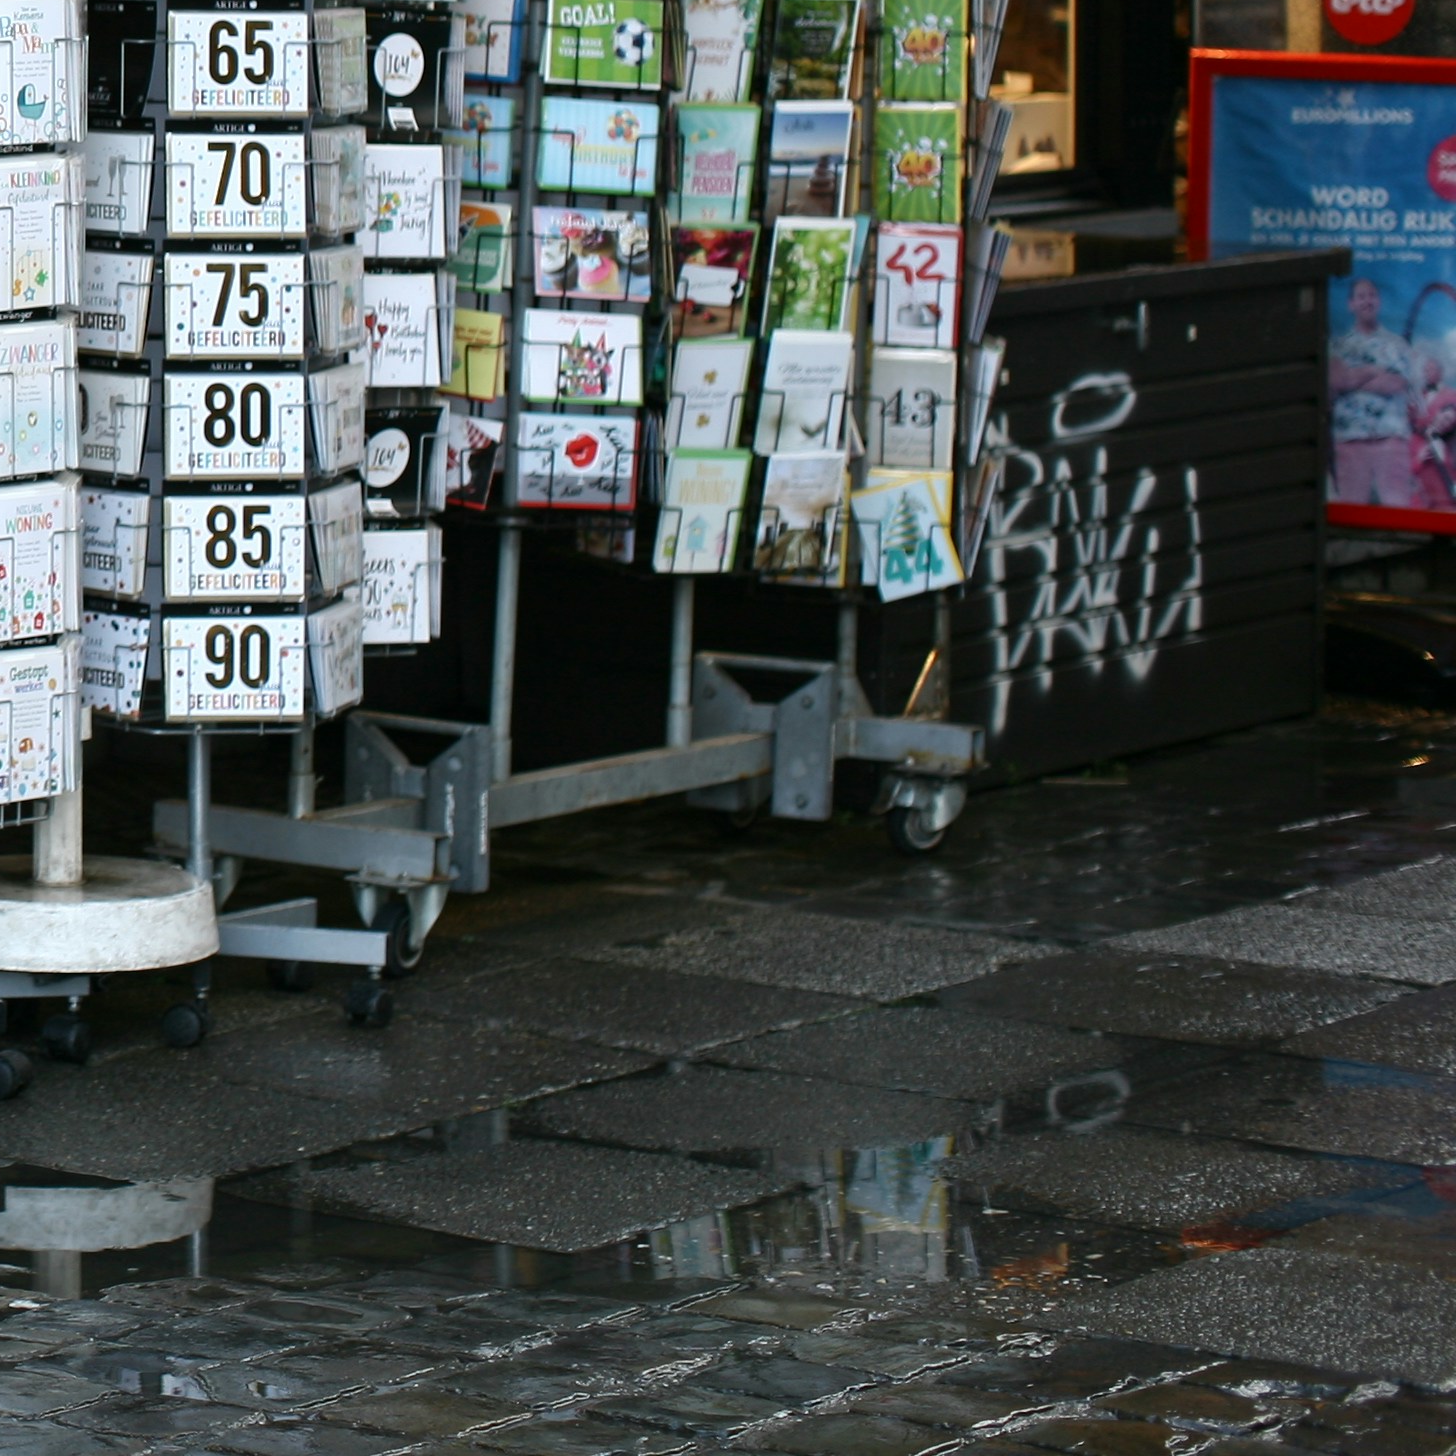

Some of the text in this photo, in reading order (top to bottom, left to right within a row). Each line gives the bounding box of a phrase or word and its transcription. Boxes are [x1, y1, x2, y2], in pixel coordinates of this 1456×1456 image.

[559, 1, 617, 27] GOAL!
[208, 19, 275, 85] 65
[192, 89, 290, 107] GEFELICITEERD
[1291, 108, 1414, 125] EUROMILLIONS
[207, 141, 271, 206] 70
[1310, 185, 1390, 209] WORD
[190, 210, 288, 227] GEFELICITEERD
[1251, 207, 1456, 232] SCHANDALIG RIJK
[886, 244, 946, 283] 42
[205, 263, 269, 328] 75
[188, 329, 286, 348] GEFELICITEERD
[0, 343, 59, 367] ZWANGER
[203, 382, 272, 448] 80
[188, 452, 286, 469] GEFELICITEERD
[6, 513, 54, 532] WONING
[205, 504, 272, 569] 85
[189, 573, 287, 591] GEFELICITEERD
[205, 624, 271, 690] 90
[8, 664, 49, 681] Gestopt
[188, 693, 286, 711] GEFELICITEERD
